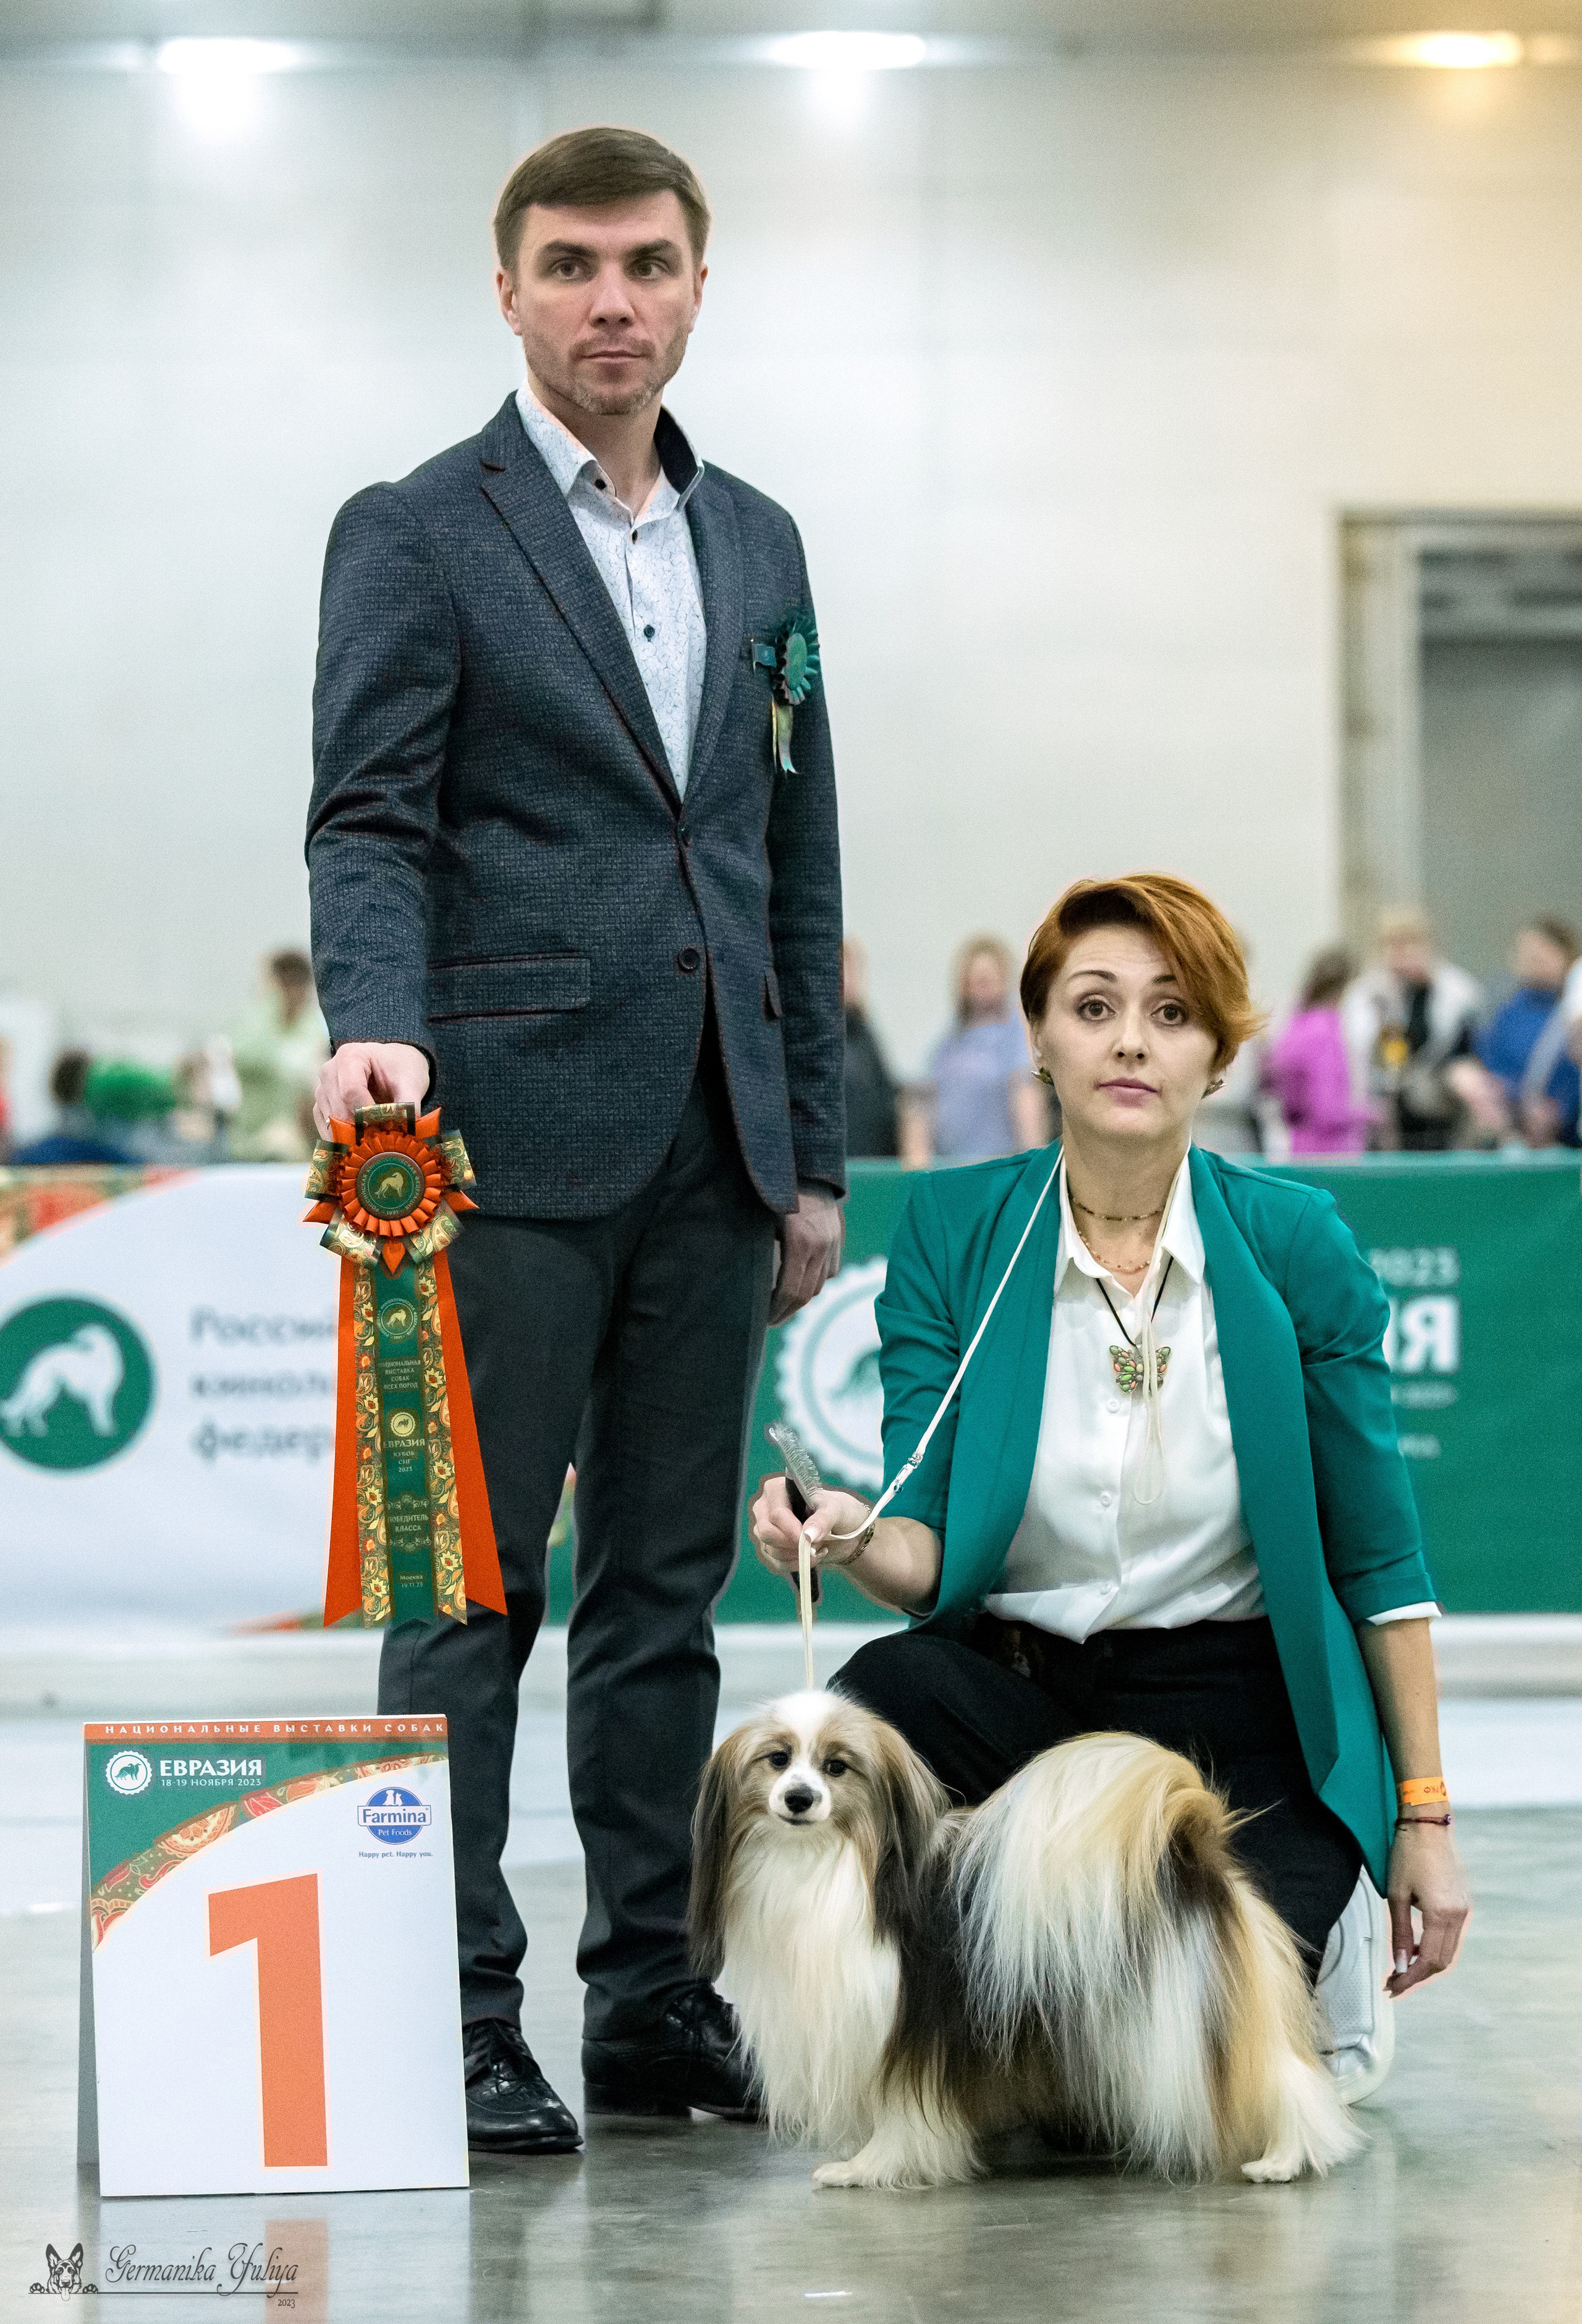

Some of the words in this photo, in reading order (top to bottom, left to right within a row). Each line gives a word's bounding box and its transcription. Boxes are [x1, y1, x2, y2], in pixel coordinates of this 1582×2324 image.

[105, 1725, 260, 1735] НАЦИОНАЛЬНЫЕ
[273, 1724, 371, 1733] ВЫСТАВКИ
[384, 1723, 444, 1732] СОБАК
[159, 1759, 262, 1777] ЕВРАЗИЯ
[161, 1778, 187, 1786] 18-19
[191, 1778, 234, 1786] НОЯБРЯ
[237, 1778, 261, 1786] 2023
[363, 1808, 426, 1823] Farmina
[208, 1874, 328, 2167] 1
